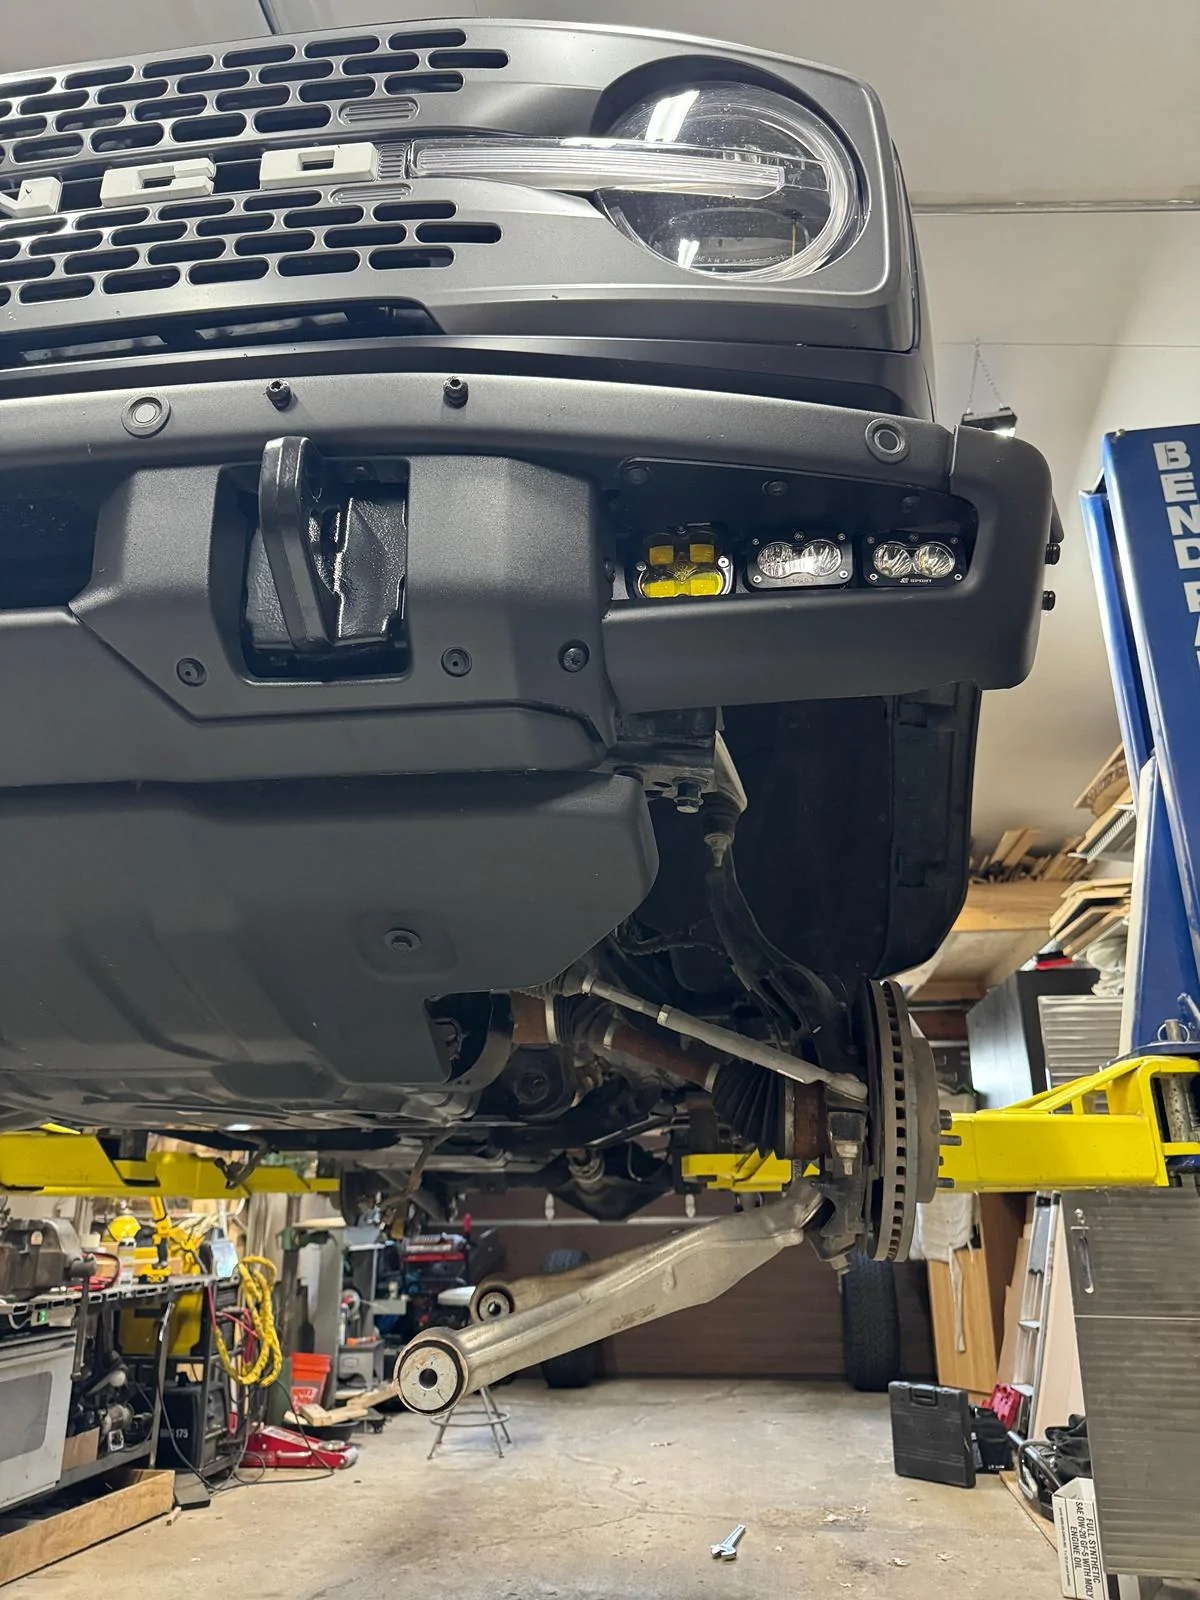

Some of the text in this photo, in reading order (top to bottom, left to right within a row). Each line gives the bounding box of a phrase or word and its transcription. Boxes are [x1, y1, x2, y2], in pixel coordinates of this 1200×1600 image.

[1075, 1501, 1084, 1515] SAE
[1070, 1526, 1082, 1570] ENGINE OIL
[1086, 1518, 1101, 1584] FULL SYNTHETIC
[1082, 1557, 1091, 1577] WITH
[1085, 1578, 1094, 1599] MOLY
